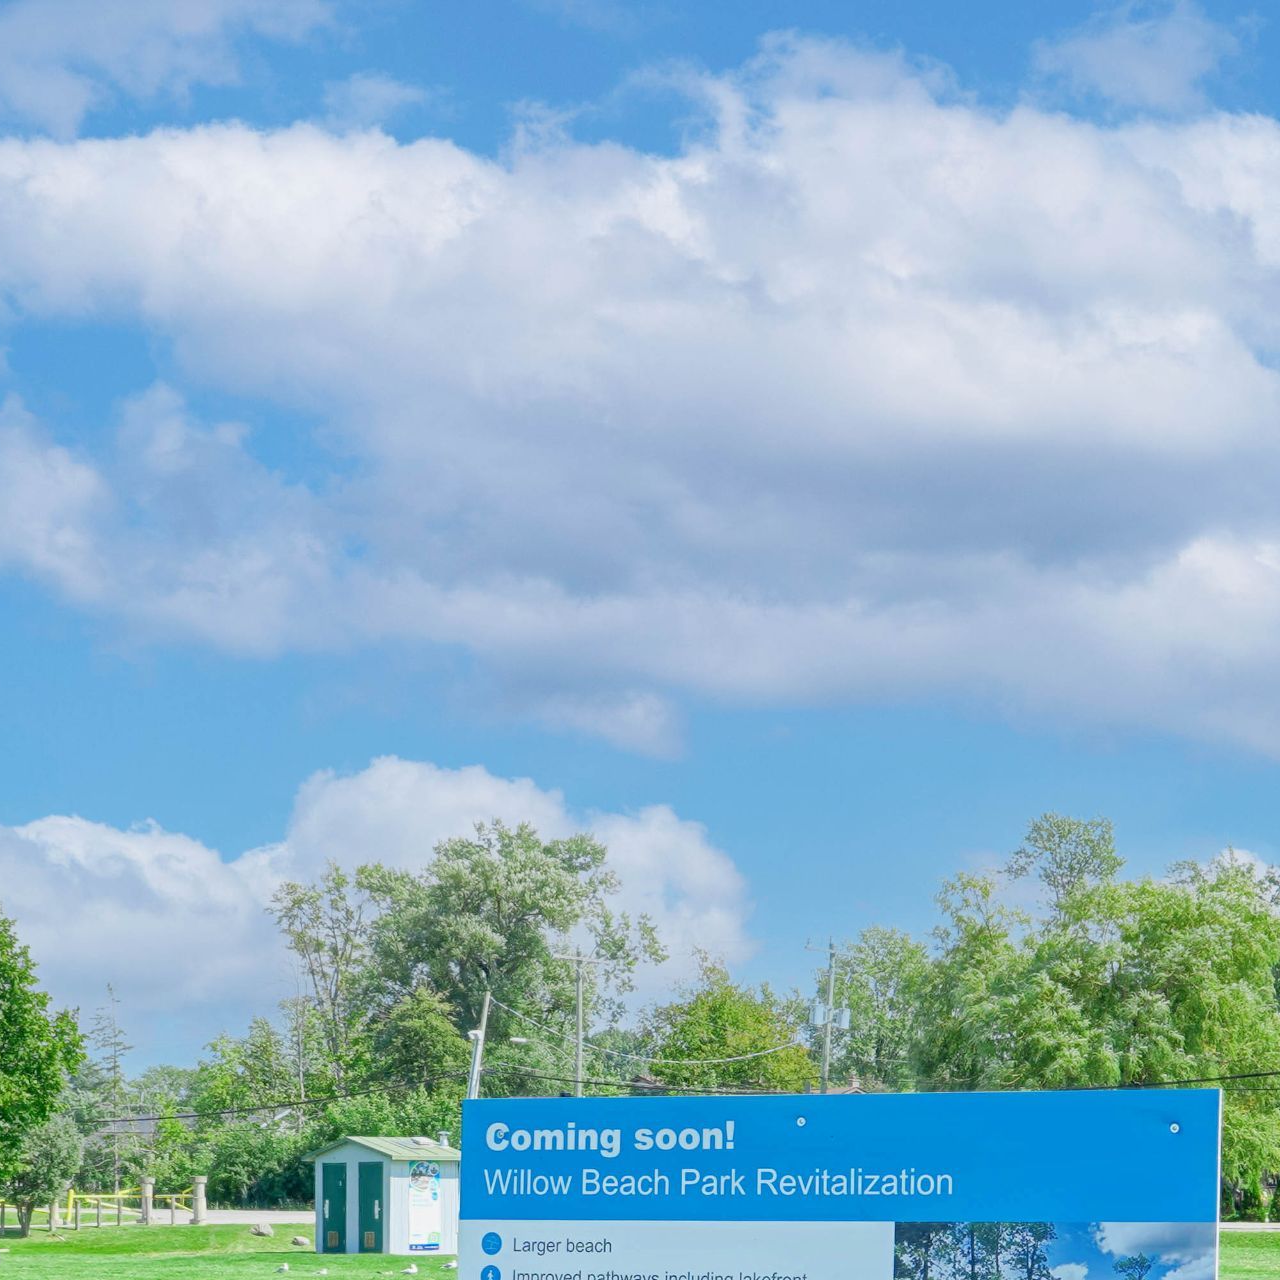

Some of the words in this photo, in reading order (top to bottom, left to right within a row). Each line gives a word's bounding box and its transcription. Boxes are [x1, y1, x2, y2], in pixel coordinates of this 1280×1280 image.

[486, 1122, 621, 1158] Coming
[634, 1120, 735, 1151] soon!
[484, 1168, 572, 1196] Willow
[582, 1168, 669, 1196] Beach
[681, 1168, 745, 1196] Park
[756, 1168, 953, 1196] Revitalization
[513, 1237, 561, 1256] Larger
[566, 1238, 612, 1254] beach
